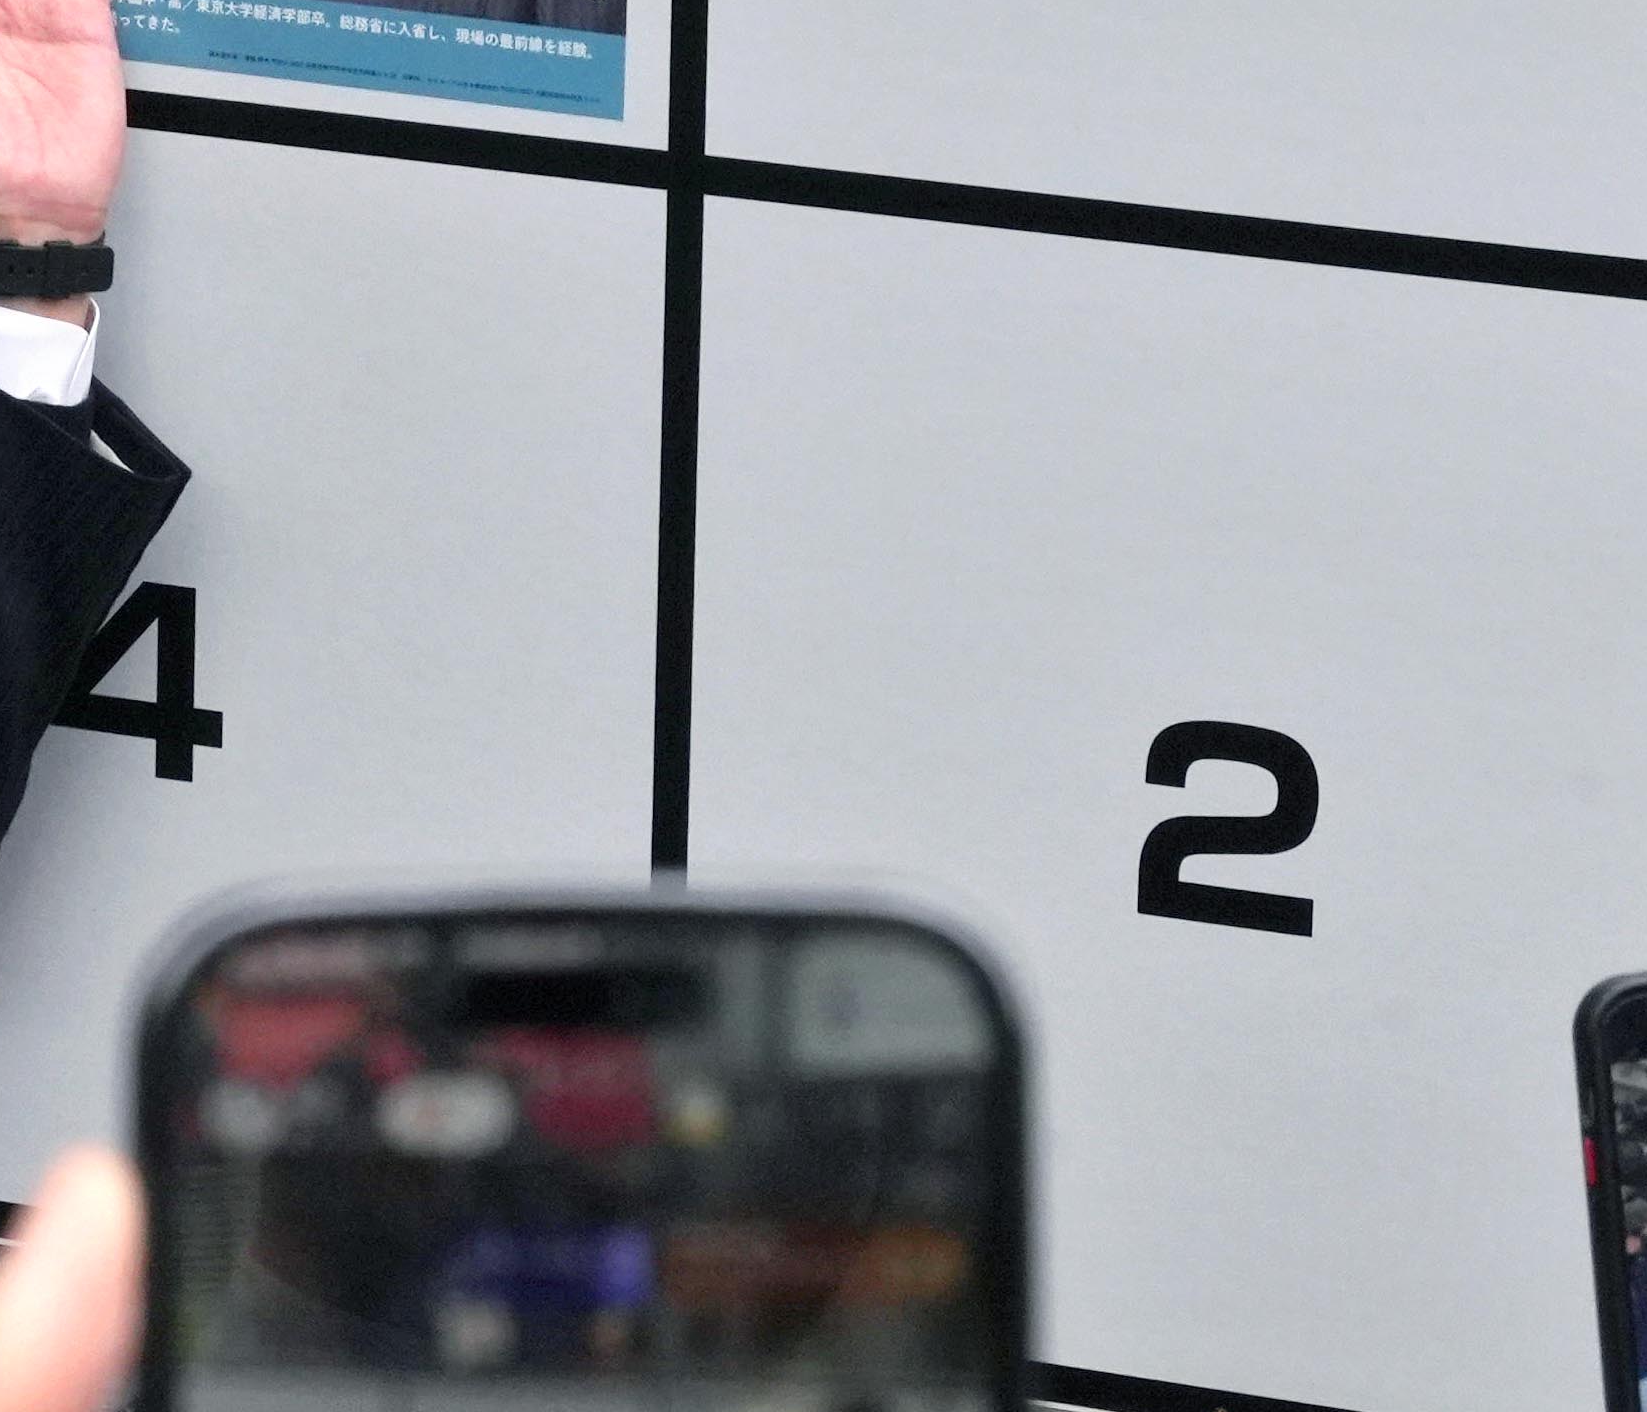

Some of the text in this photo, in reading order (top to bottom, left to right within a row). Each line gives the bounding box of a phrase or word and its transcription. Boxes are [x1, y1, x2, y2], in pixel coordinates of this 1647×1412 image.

[109, 9, 181, 35] ってきた。
[46, 581, 224, 783] 4
[1137, 720, 1319, 938] 2
